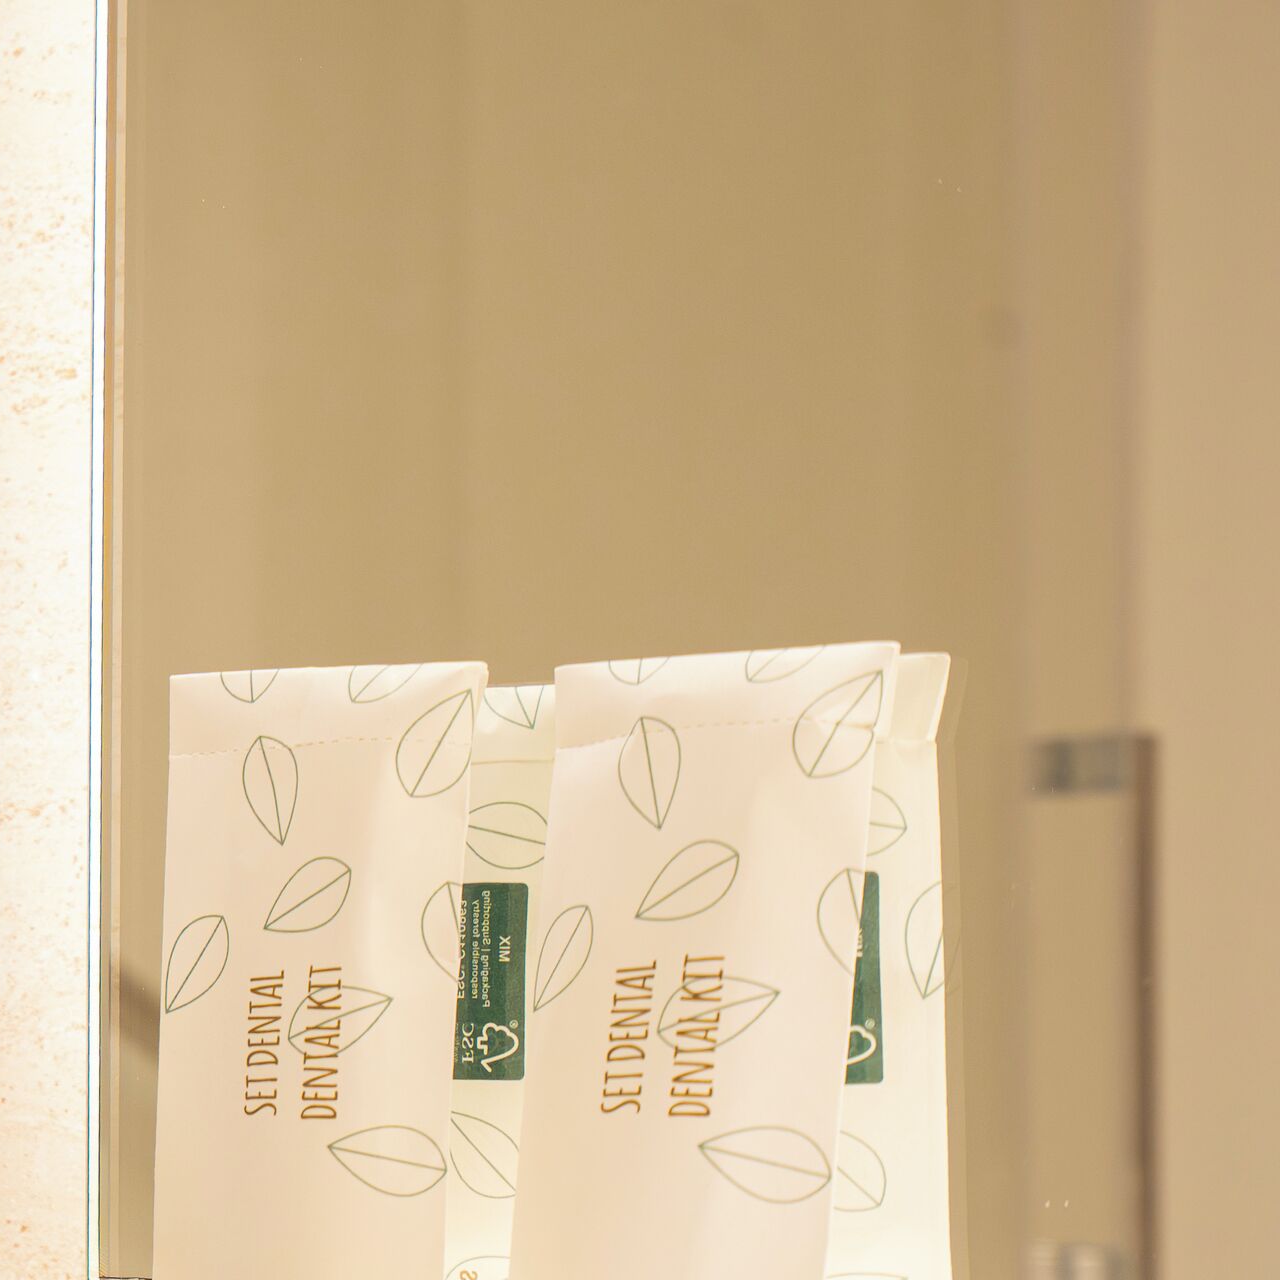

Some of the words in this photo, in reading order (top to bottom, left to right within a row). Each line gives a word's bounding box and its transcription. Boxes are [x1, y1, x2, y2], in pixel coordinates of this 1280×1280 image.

[306, 965, 342, 1011] KIT
[606, 960, 657, 1062] DENTAL
[680, 954, 725, 1002] KIT
[246, 969, 285, 1067] DENTAL
[243, 1075, 278, 1116] SET
[300, 1018, 341, 1120] DENTAL
[600, 1071, 644, 1114] SET
[668, 1011, 721, 1117] DENTAL
